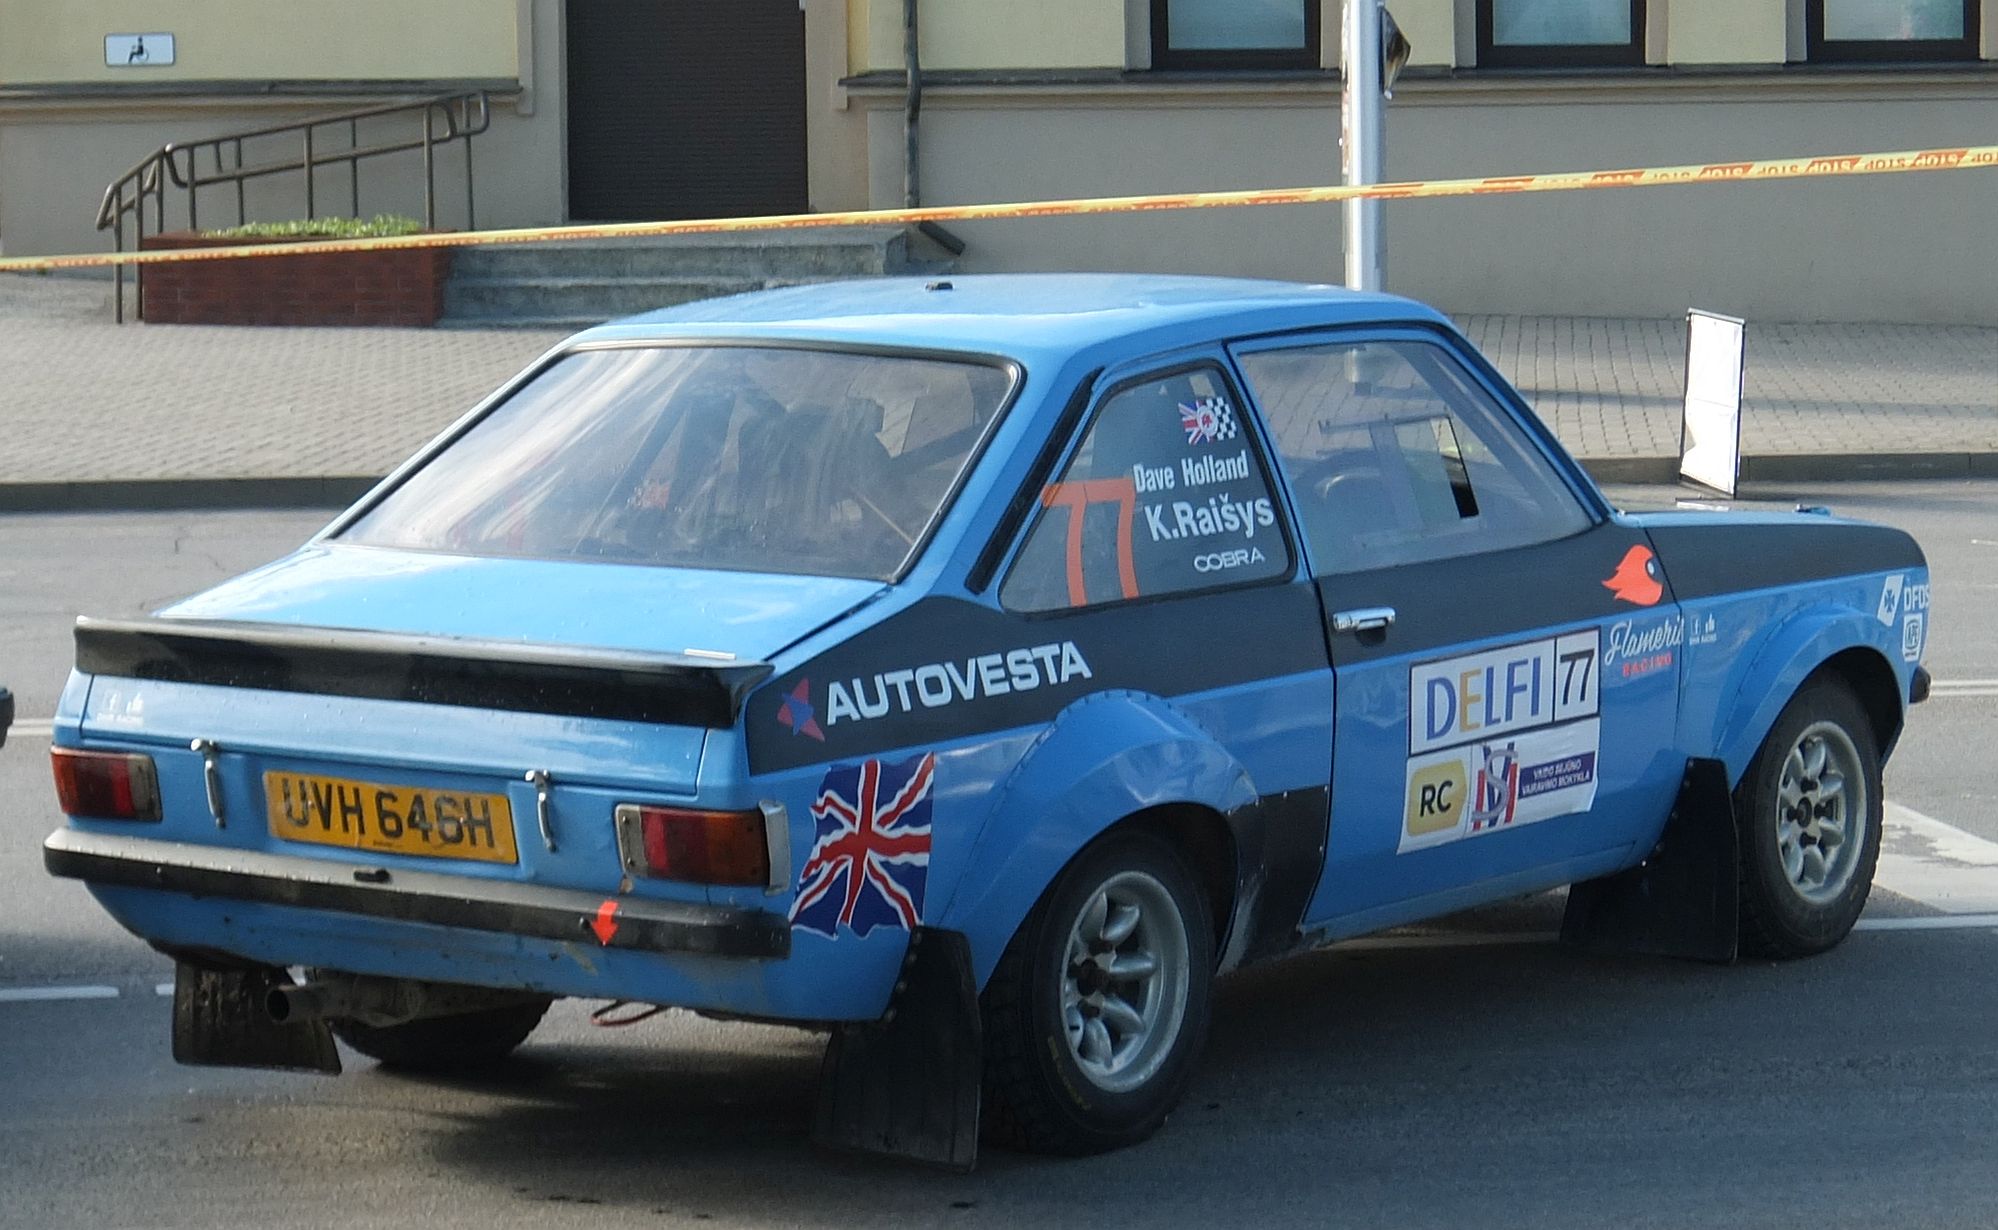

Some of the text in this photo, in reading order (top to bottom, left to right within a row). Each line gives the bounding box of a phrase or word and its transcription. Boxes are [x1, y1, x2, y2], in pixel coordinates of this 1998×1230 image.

[1808, 160, 1851, 173] STOP
[1133, 450, 1249, 494] Dave Holland
[1041, 477, 1140, 607] 77
[1144, 492, 1274, 542] K.Raišys
[1194, 546, 1266, 573] COBRA
[827, 641, 1093, 726] AUTOVESTA
[1426, 656, 1542, 741] DELFI
[1559, 648, 1596, 706] 77
[282, 778, 495, 848] UVH 646H
[1420, 780, 1453, 817] RC
